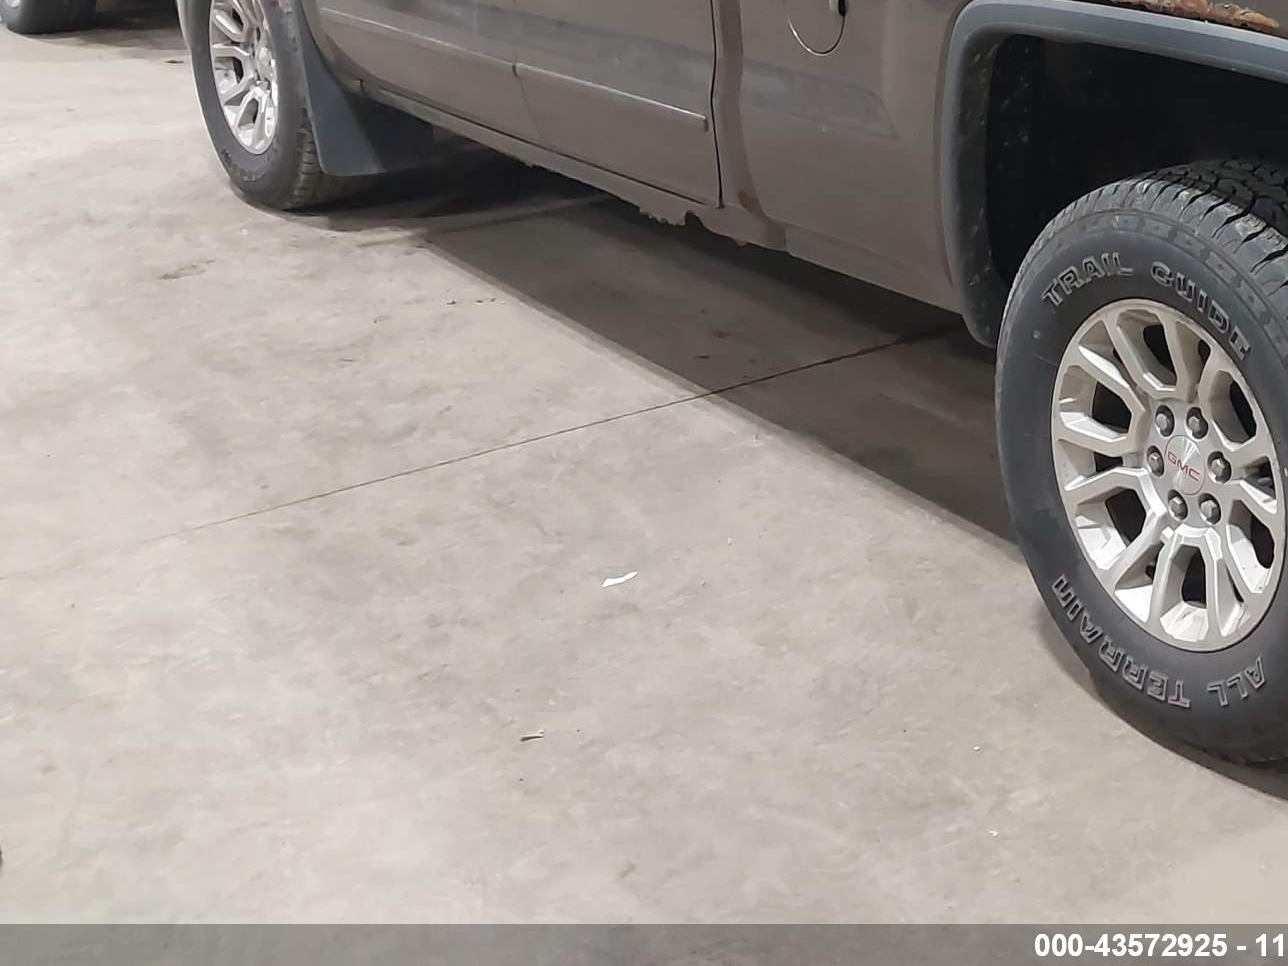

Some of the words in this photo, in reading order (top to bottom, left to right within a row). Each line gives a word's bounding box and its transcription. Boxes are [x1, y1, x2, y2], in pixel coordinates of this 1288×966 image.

[1042, 251, 1135, 308] TRAIL
[1151, 260, 1251, 361] GUIDE
[1167, 450, 1201, 481] GMC
[1051, 573, 1191, 708] TERRAIN
[1206, 655, 1266, 707] ALL
